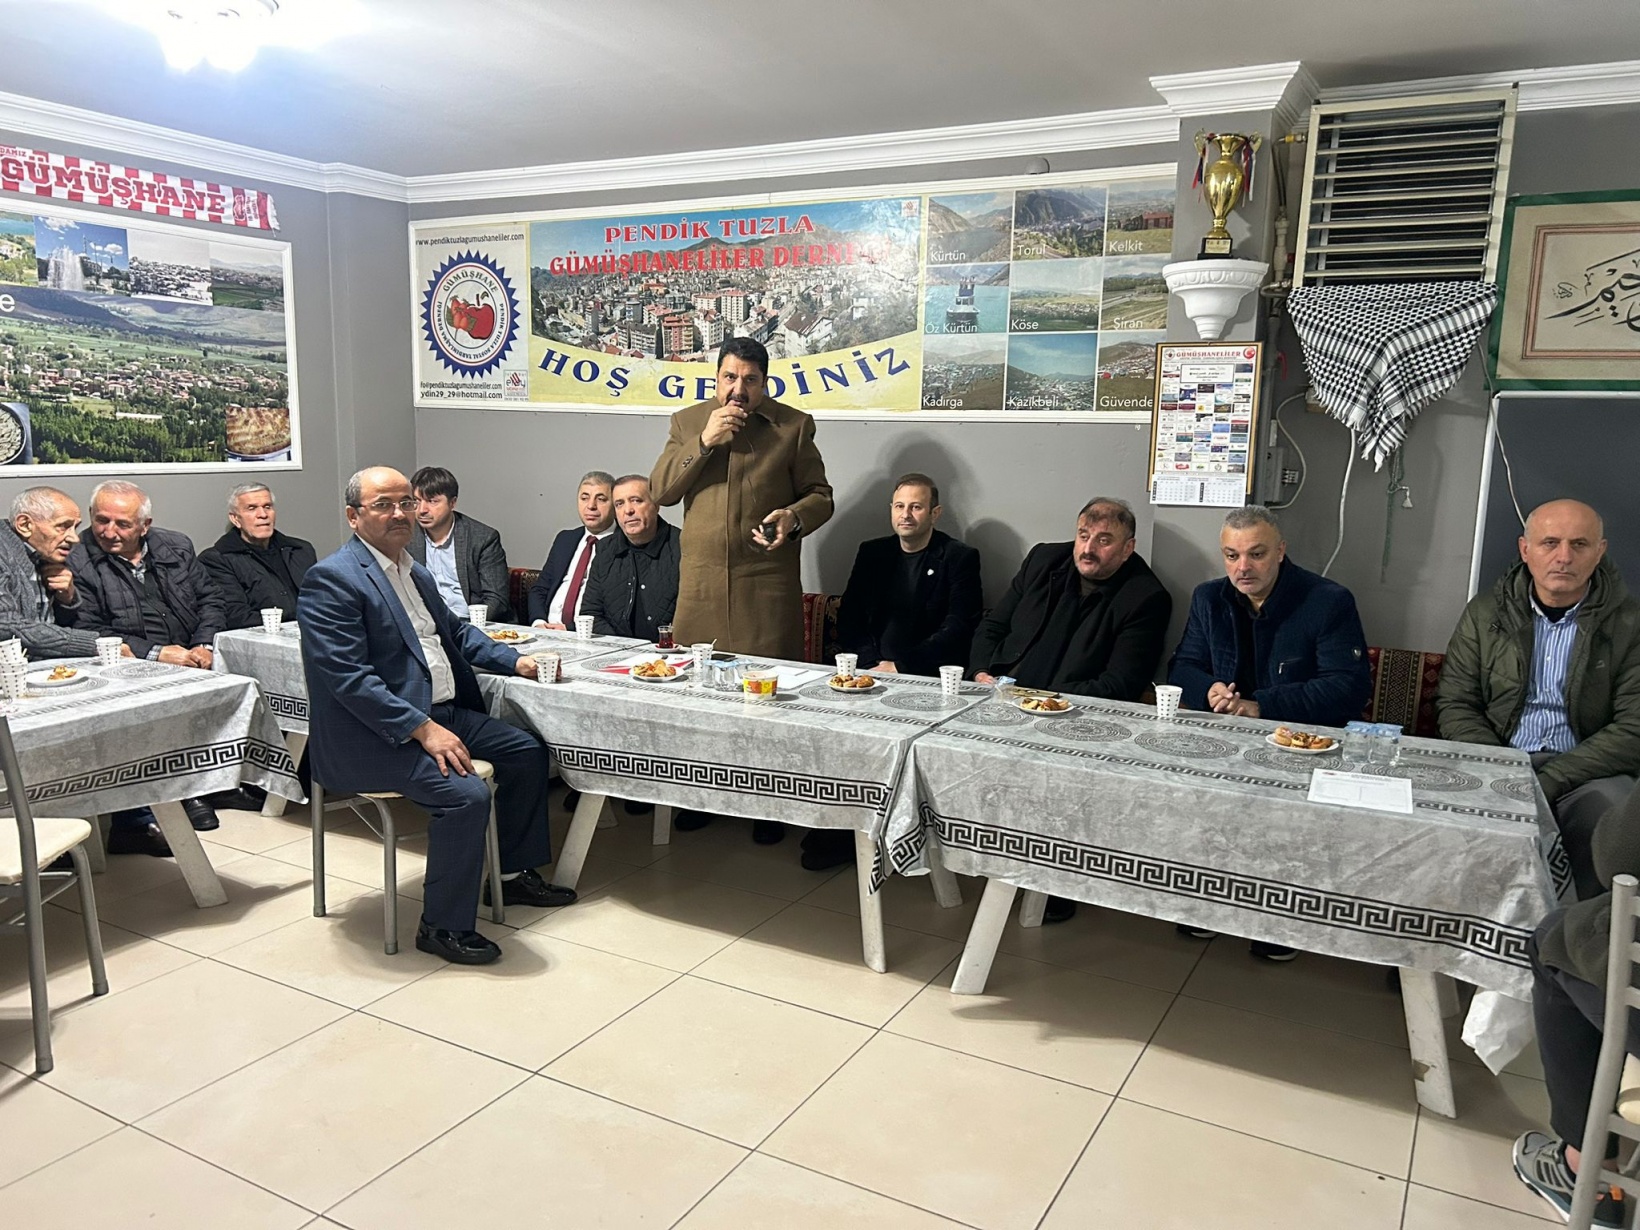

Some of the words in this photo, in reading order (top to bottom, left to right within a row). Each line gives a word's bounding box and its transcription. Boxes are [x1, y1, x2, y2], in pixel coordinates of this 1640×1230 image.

[1, 154, 226, 214] GÜMÜŞHANE
[605, 217, 711, 243] PENDİK
[719, 215, 815, 238] TUZLA
[1017, 244, 1046, 256] Torul
[1109, 241, 1143, 253] Kelkit
[550, 245, 765, 279] GÜMÜŞHANELİLER
[931, 249, 966, 262] Kürtün
[443, 269, 499, 293] GÜMÜŞHANE
[943, 321, 978, 333] Kürtün
[1011, 319, 1039, 331] Köse
[1113, 317, 1143, 331] Şiran
[538, 348, 631, 397] HOŞ
[658, 347, 911, 401] GEDİNİZ
